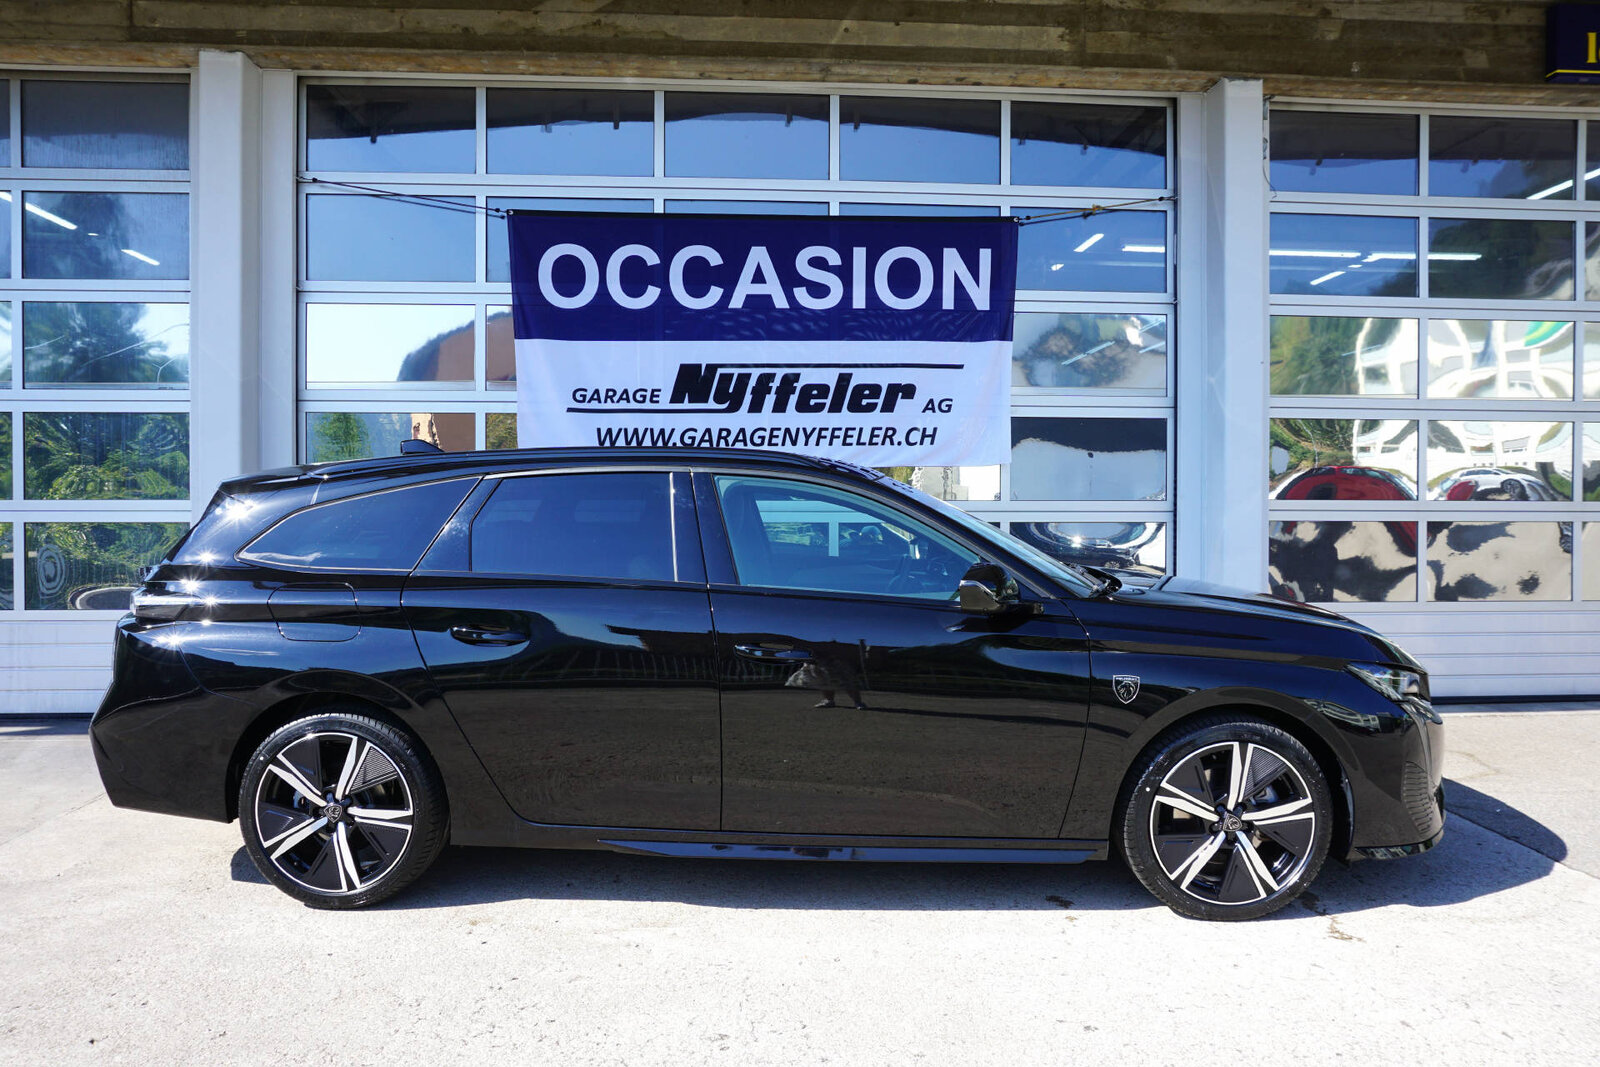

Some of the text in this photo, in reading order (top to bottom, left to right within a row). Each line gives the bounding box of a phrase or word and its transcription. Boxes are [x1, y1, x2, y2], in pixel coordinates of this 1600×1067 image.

[537, 243, 992, 311] OCCASION
[572, 363, 954, 414] GARAGE Nyffeler AG
[597, 427, 938, 448] WWW.GARAGENYFFELER.CH
